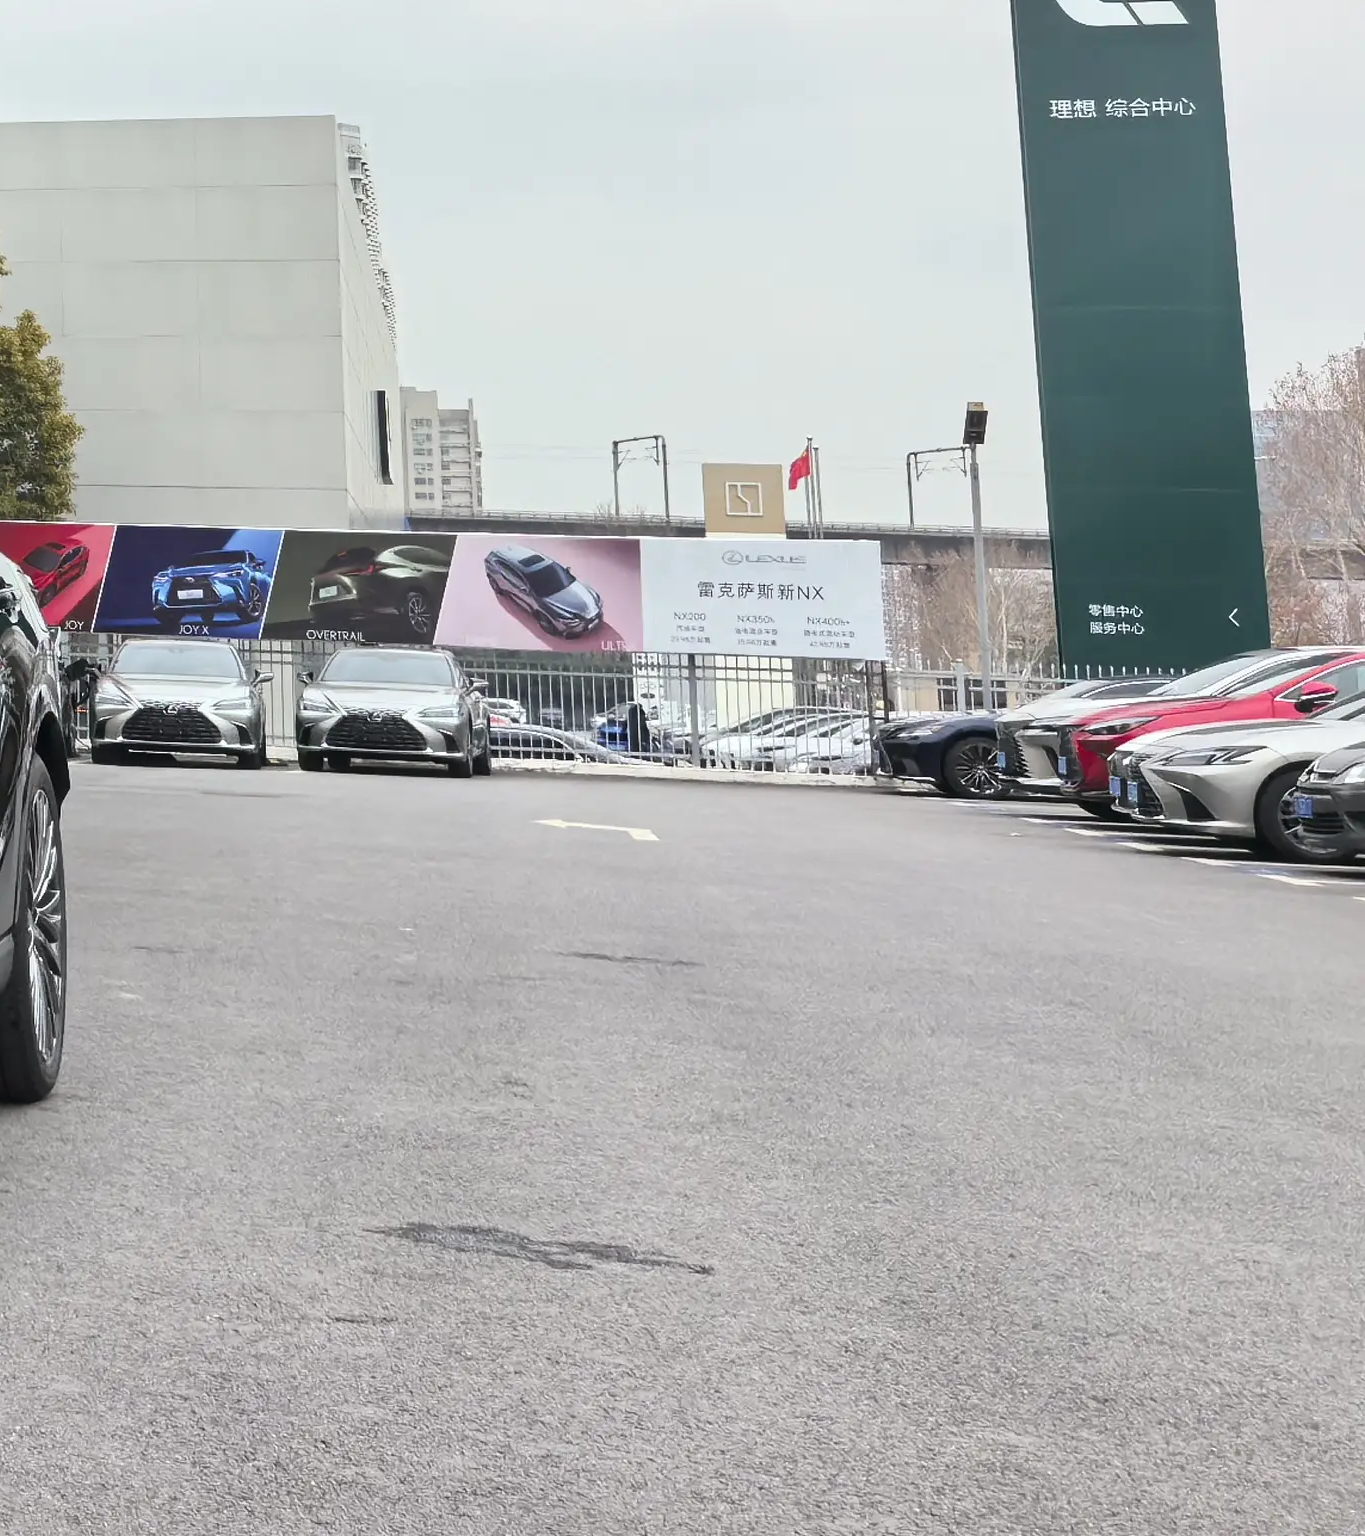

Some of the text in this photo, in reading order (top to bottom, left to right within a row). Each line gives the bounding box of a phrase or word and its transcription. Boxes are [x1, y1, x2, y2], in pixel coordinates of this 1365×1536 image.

[1049, 97, 1196, 119] 理想 综合中心
[698, 580, 825, 601] 雷克萨斯新NX
[1088, 603, 1144, 618] 零售中心
[64, 620, 84, 631] JOY
[178, 624, 199, 635] JOY
[1089, 621, 1145, 635] 服务中心
[305, 629, 366, 642] OVERTRAIL
